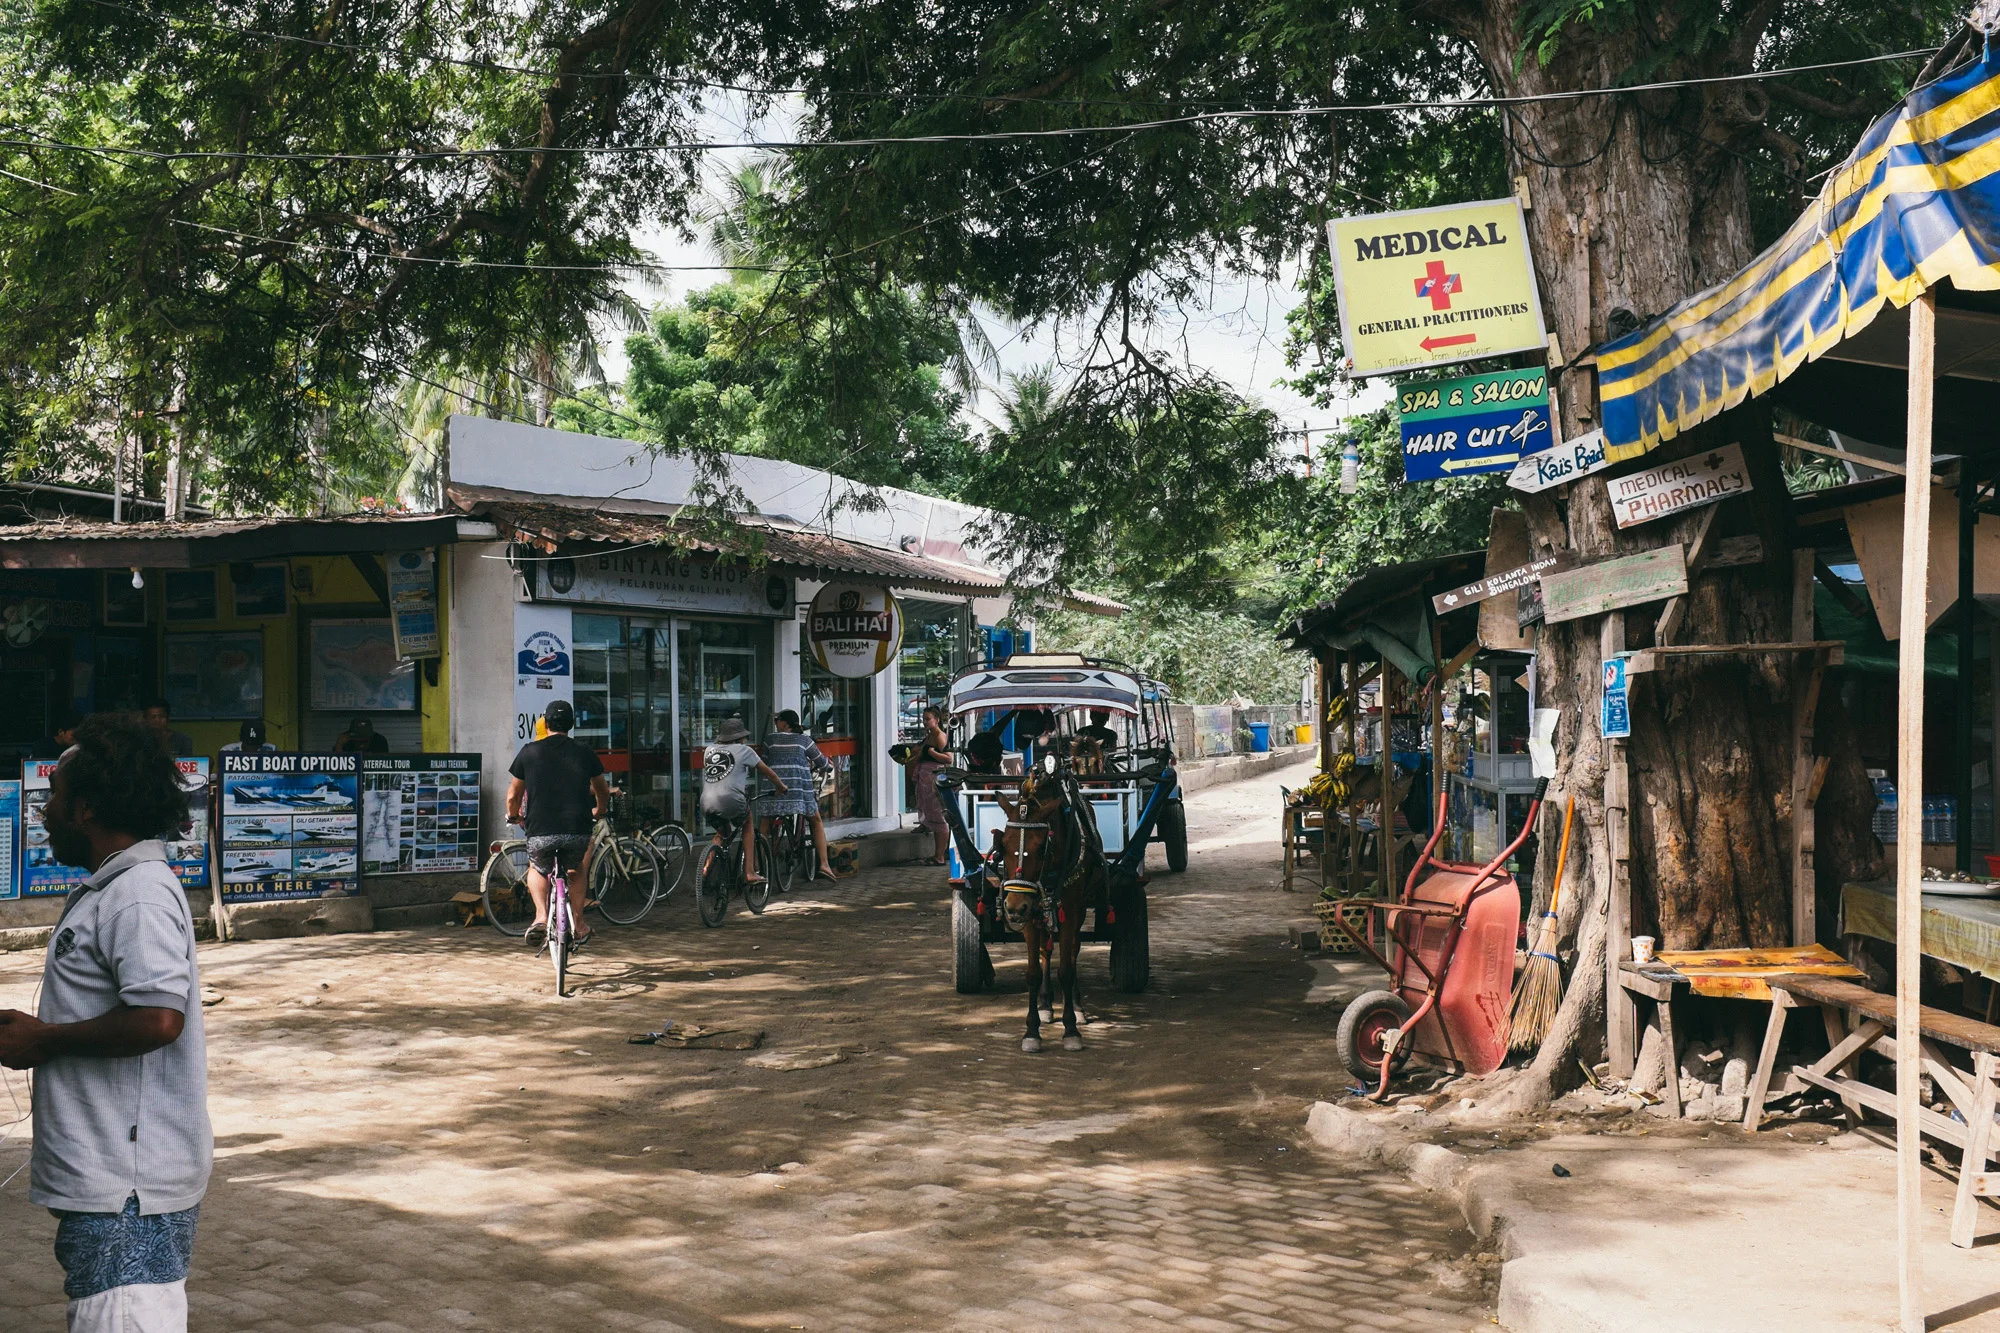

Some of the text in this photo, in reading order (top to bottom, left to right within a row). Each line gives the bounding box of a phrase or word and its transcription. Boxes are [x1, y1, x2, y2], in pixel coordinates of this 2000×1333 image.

[1354, 222, 1507, 262] MEDICAL
[1358, 302, 1529, 336] GENERAL PRACTITIONERS
[1401, 376, 1545, 414] SPA & SALON
[1406, 425, 1511, 456] HAIR CUT
[1537, 455, 1574, 486] Kai's
[1620, 462, 1697, 496] MEDICAL
[1628, 471, 1745, 520] PHARMACY
[599, 554, 691, 579] BINTANG
[700, 565, 749, 584] SHOP
[1463, 557, 1557, 596] GILI KOLANTA INDAH
[619, 577, 732, 597] PELABUHAN GILI AIR
[1488, 573, 1542, 597] BUNGALOWS
[814, 615, 888, 632] BALI HAI
[829, 641, 870, 650] PREMIUM
[225, 756, 356, 771] FAST BOAT OPTIONS
[362, 760, 468, 769] ATERFALL TOUR RINJANI TREKKING
[227, 774, 268, 782] PATAGONIA
[226, 819, 246, 827] SUPER
[308, 816, 334, 825] GETAWAY
[29, 883, 72, 893] FOR FURT
[223, 880, 313, 895] BOOK HERE
